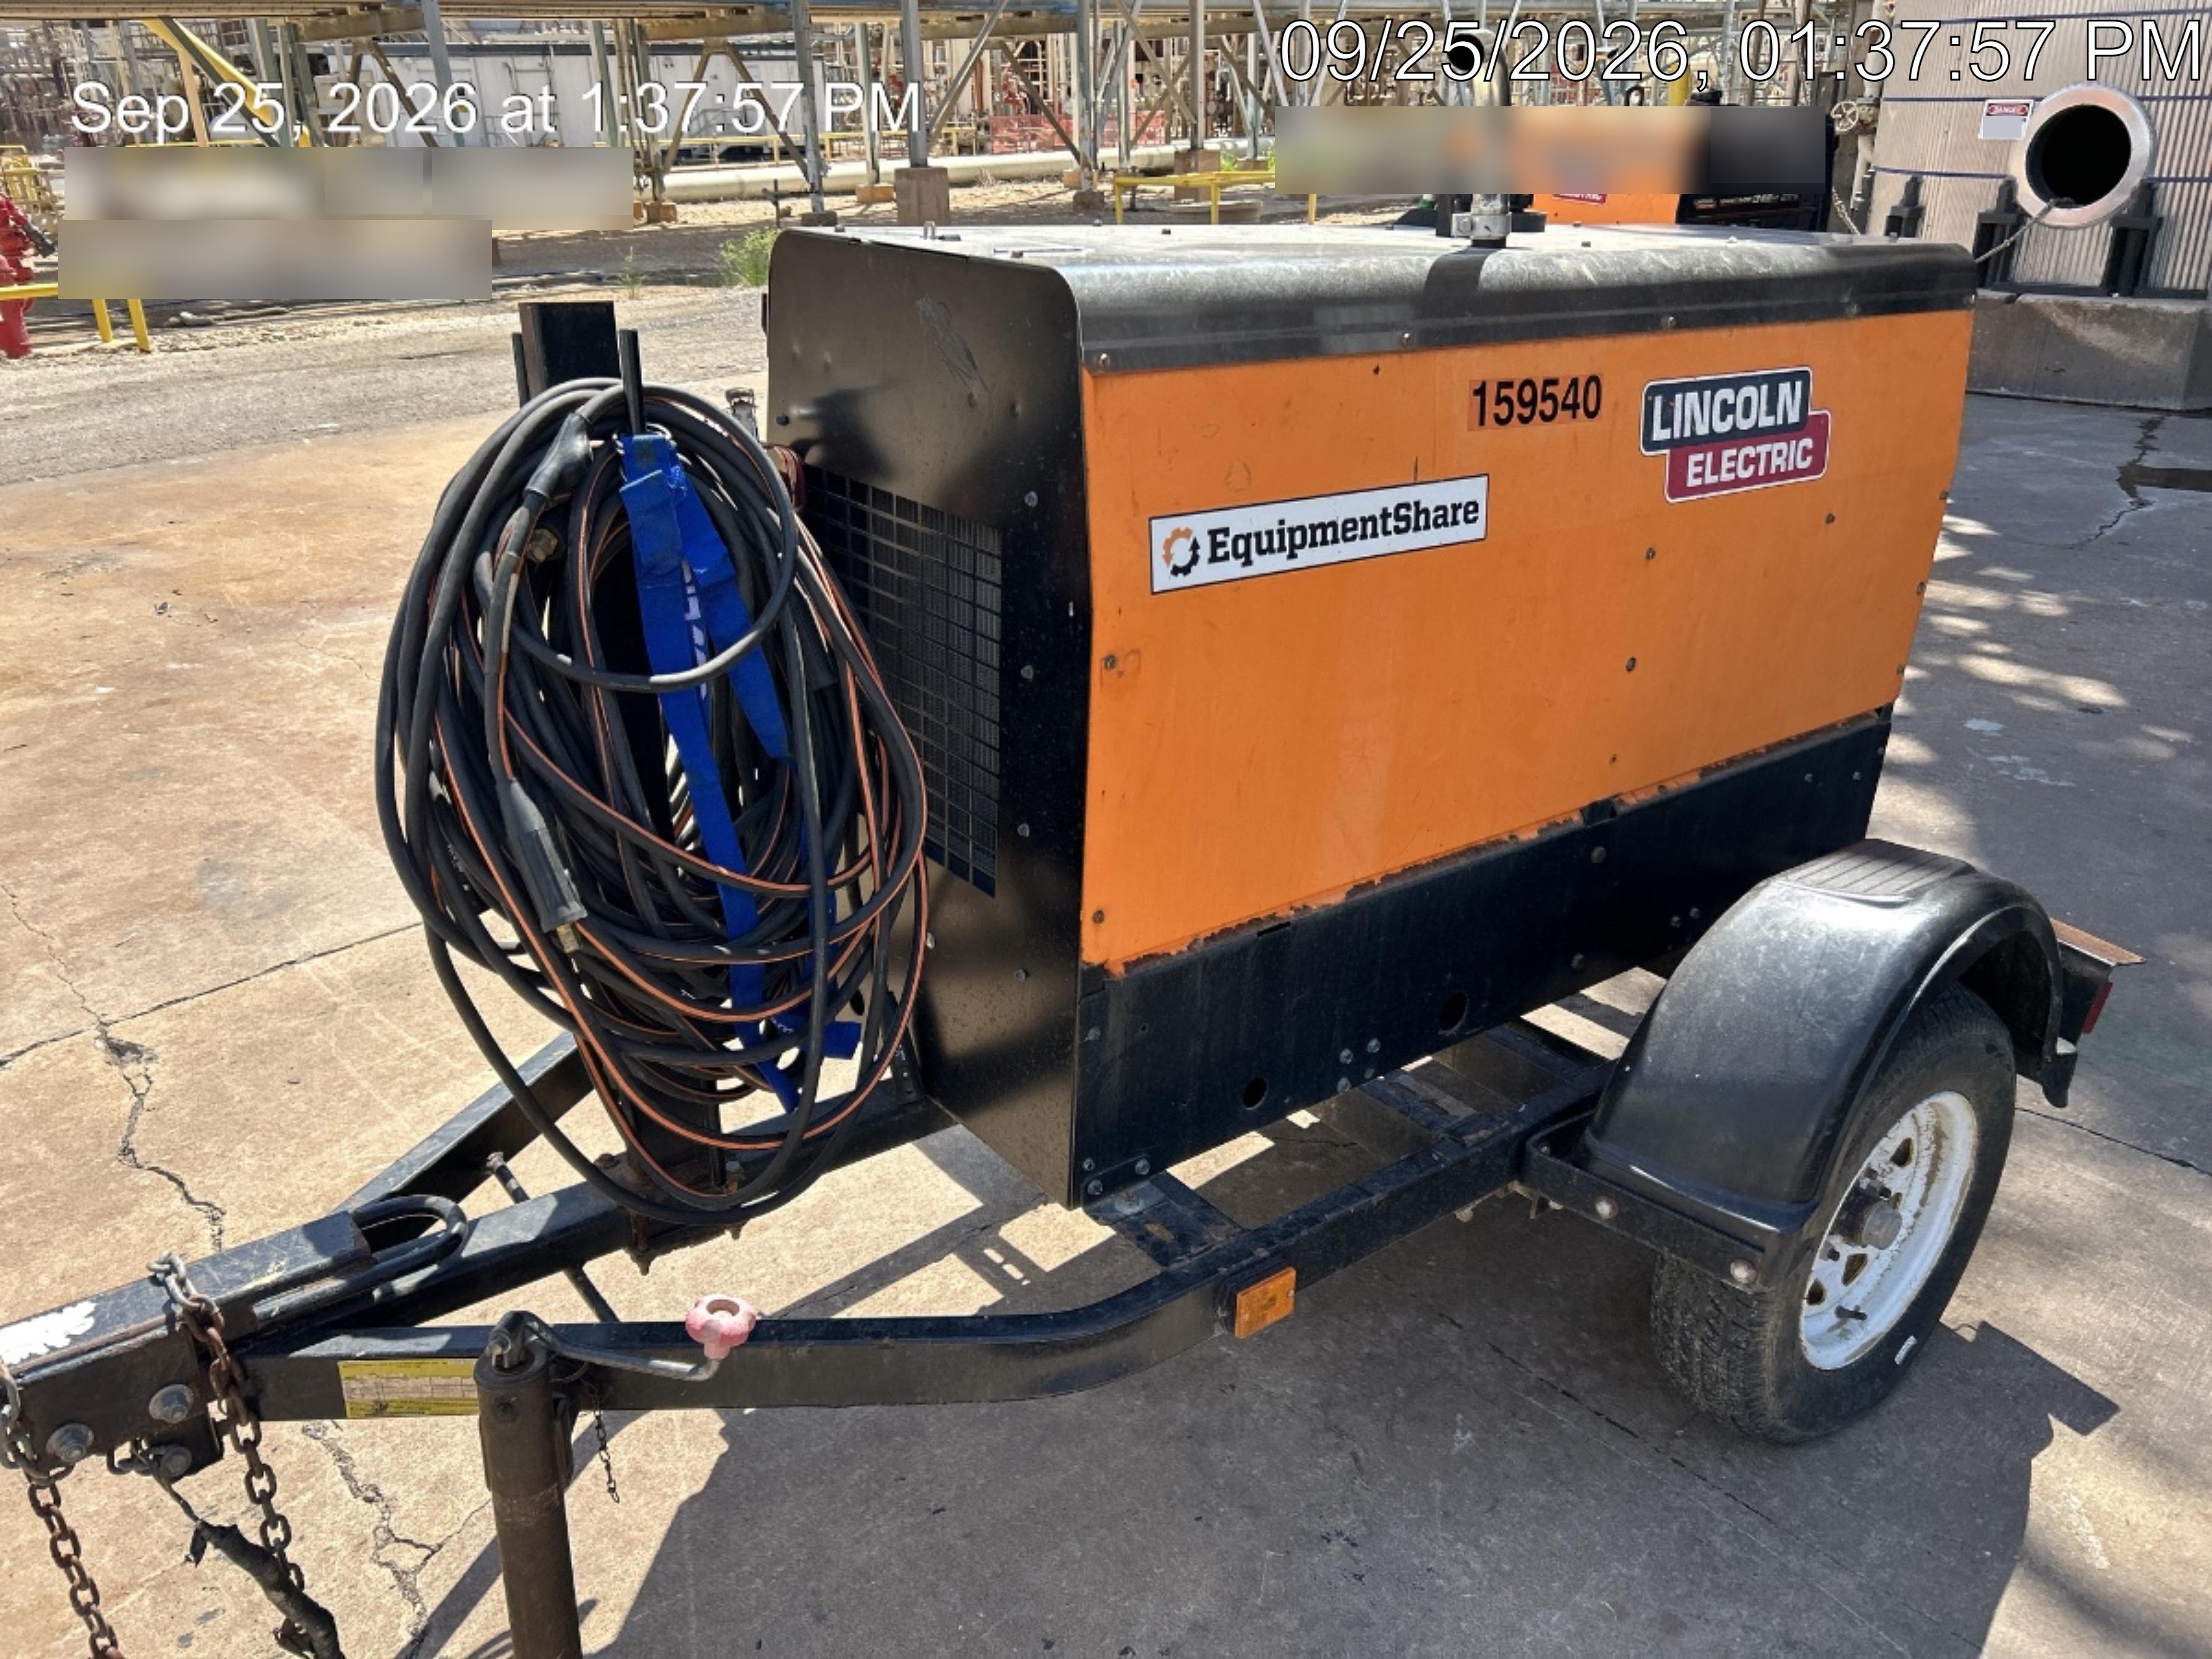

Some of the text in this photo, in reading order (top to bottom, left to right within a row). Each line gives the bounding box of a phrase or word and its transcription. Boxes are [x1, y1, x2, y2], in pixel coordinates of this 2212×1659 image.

[1472, 375, 1602, 427] 159540
[1652, 381, 1802, 442] LINCOLN
[1686, 438, 1813, 487] ELECTRIC
[1207, 500, 1480, 568] EquipmentShare
